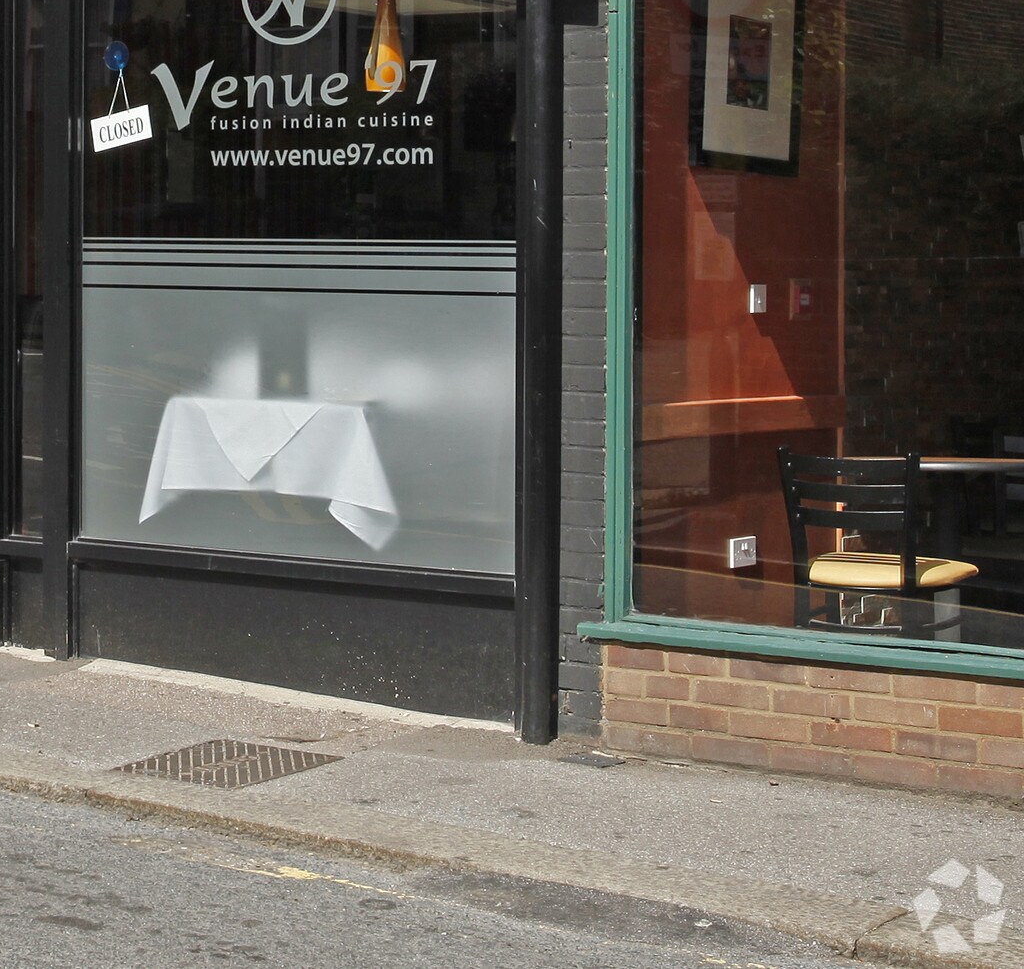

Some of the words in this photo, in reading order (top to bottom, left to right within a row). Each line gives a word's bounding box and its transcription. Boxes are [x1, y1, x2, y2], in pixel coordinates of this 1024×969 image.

[150, 59, 349, 131] Venue
[98, 116, 144, 145] CLOSED
[210, 115, 272, 130] fusion
[283, 114, 347, 129] indian
[358, 112, 434, 127] cuisine
[210, 143, 434, 167] www.venue97.com
